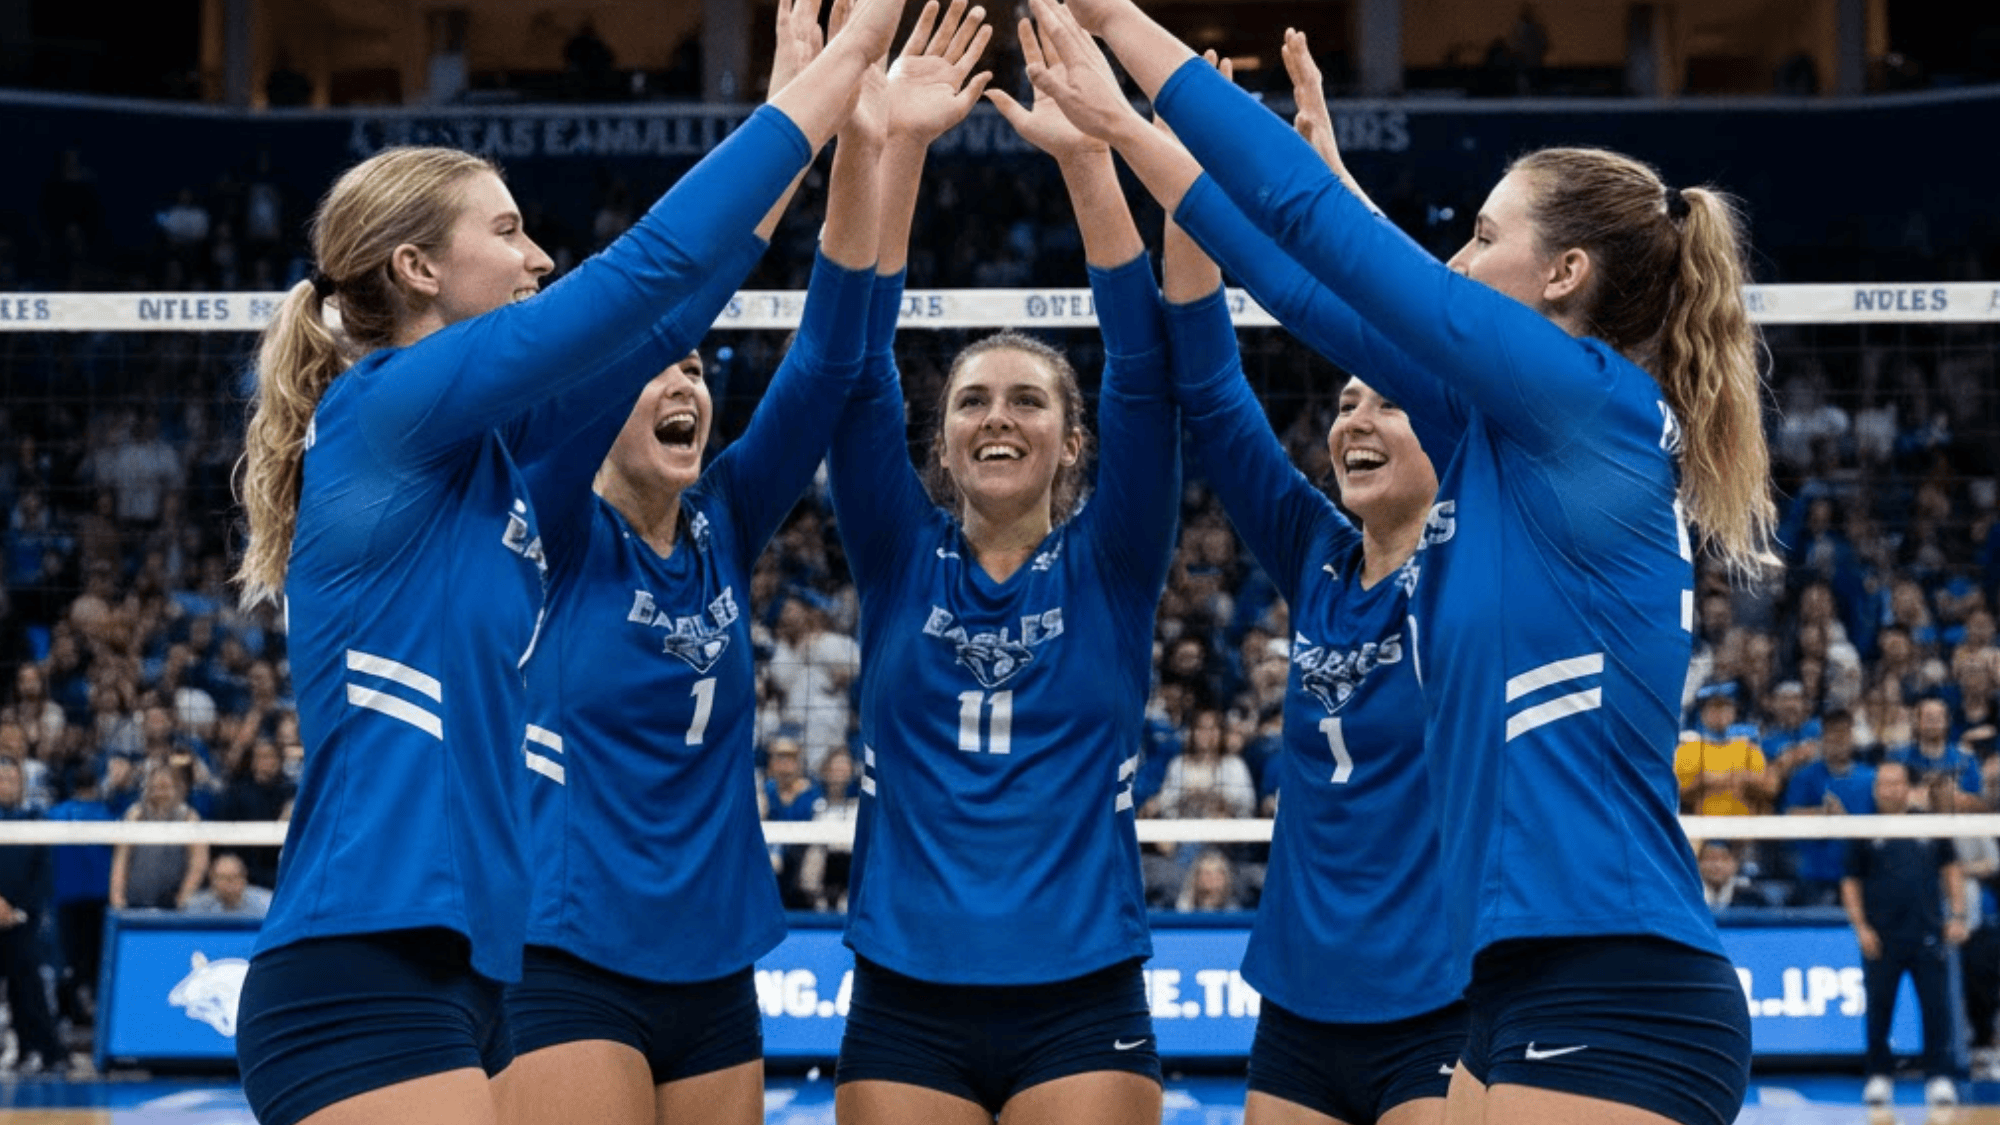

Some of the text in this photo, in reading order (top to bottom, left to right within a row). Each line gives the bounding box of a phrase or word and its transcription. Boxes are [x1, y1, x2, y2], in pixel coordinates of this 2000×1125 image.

[685, 677, 717, 745] 1
[957, 690, 1013, 754] 11
[1318, 717, 1354, 783] 1
